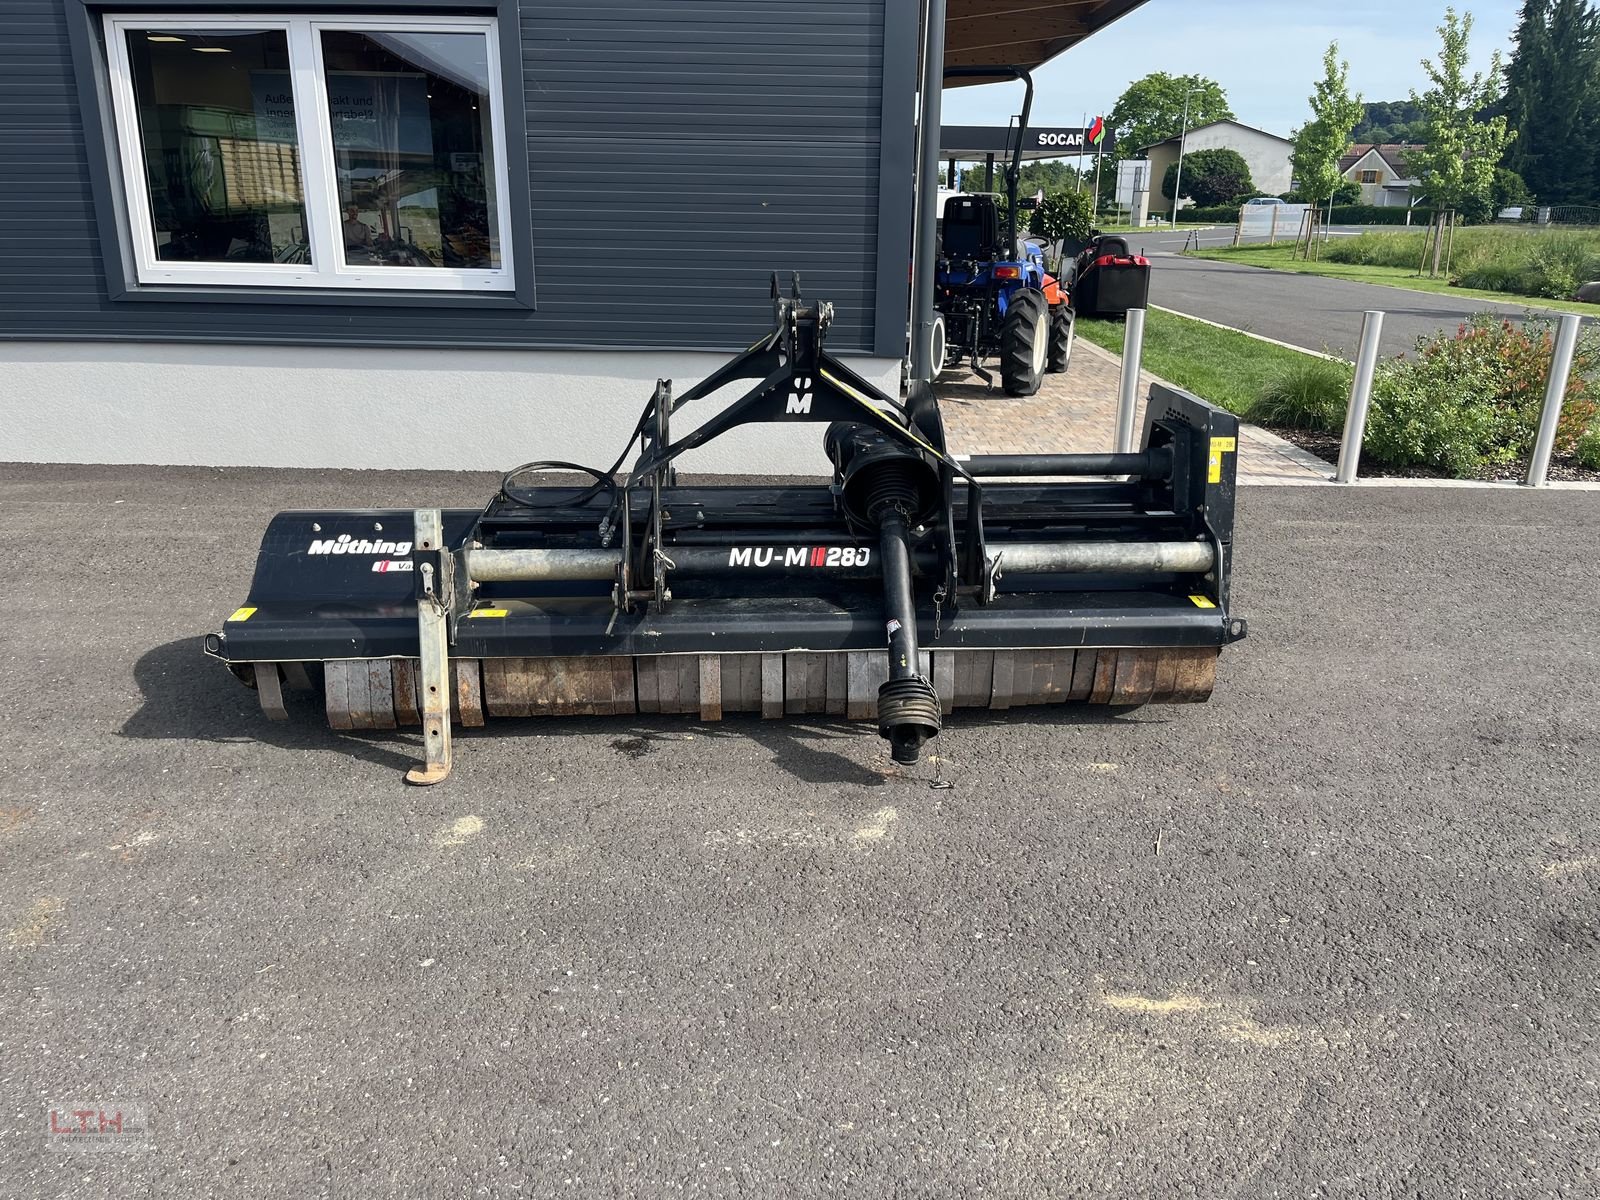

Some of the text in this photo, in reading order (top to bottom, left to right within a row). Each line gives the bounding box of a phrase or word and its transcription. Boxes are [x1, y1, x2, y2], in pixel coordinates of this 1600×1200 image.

[353, 96, 373, 105] und
[1038, 133, 1084, 146] SOCAR
[308, 534, 413, 556] Müthing
